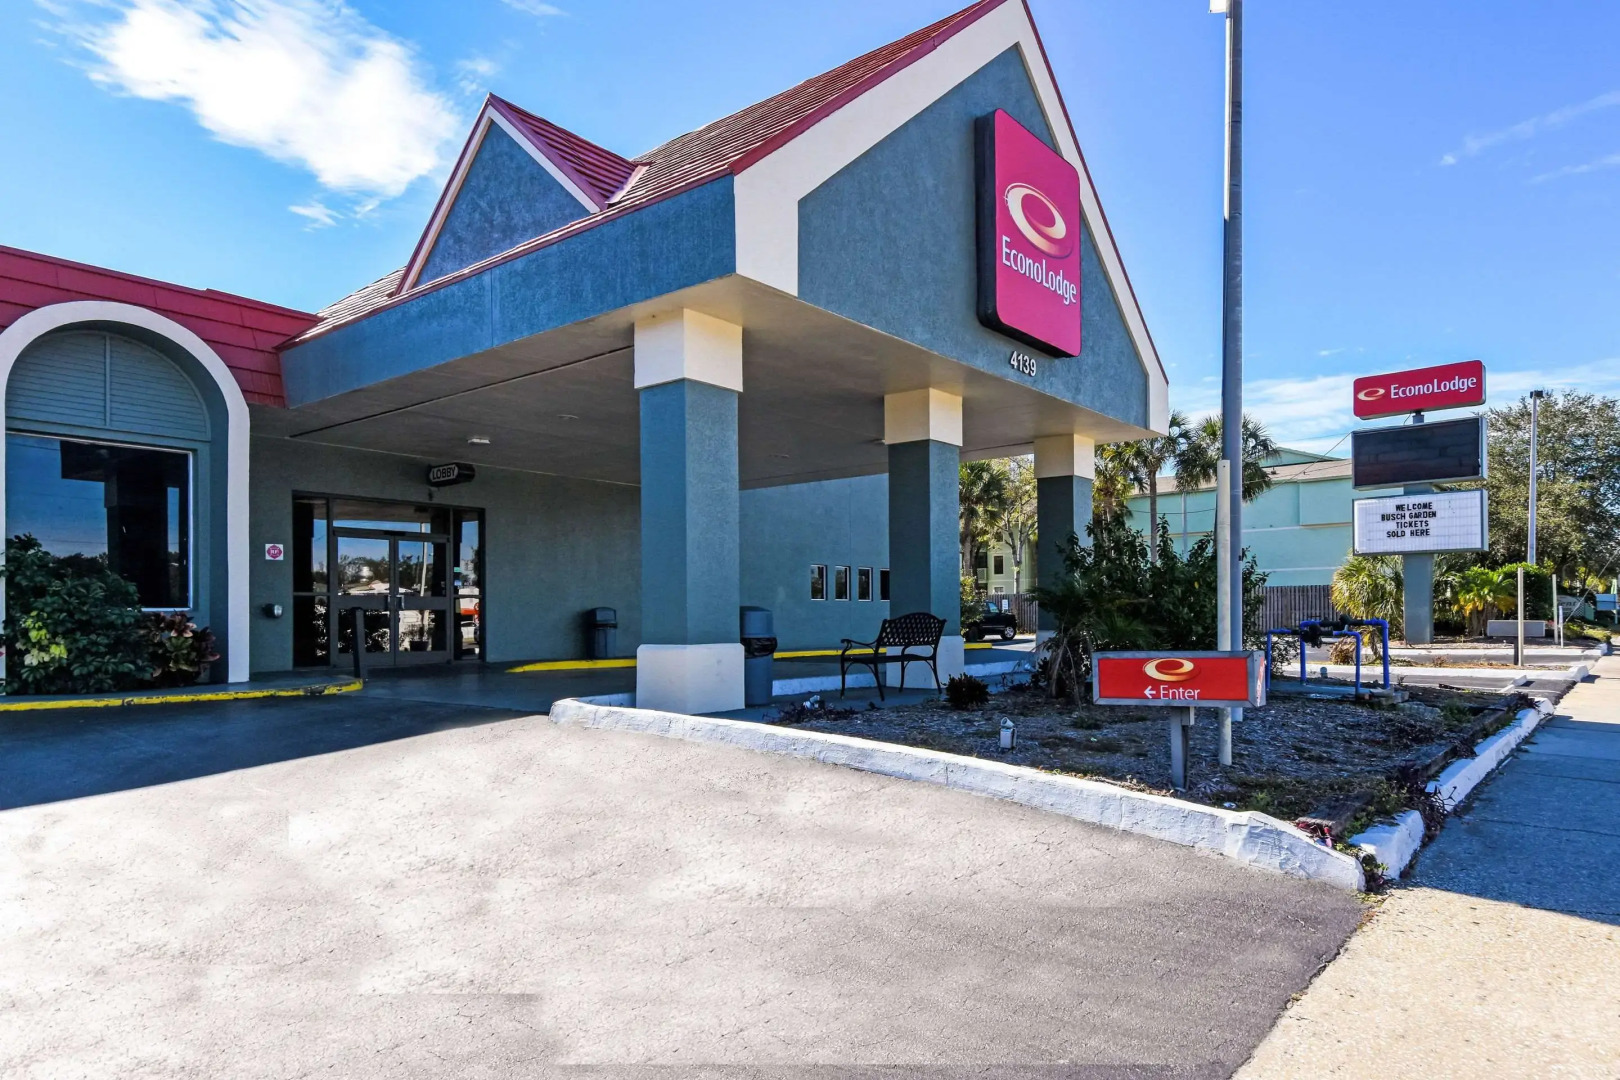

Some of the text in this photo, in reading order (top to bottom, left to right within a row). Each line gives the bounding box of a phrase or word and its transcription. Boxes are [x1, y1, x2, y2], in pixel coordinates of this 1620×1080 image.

[1002, 234, 1077, 305] EconoLodge
[1010, 350, 1037, 376] 4139
[1390, 376, 1477, 399] EconoLodge
[432, 466, 456, 480] LOBBY
[1395, 502, 1433, 512] WELCOME
[1381, 511, 1437, 521] BUSCH GARDEN
[1396, 520, 1429, 529] TICKETS
[1386, 529, 1430, 538] SOLD HERE
[1160, 685, 1200, 700] Enter
